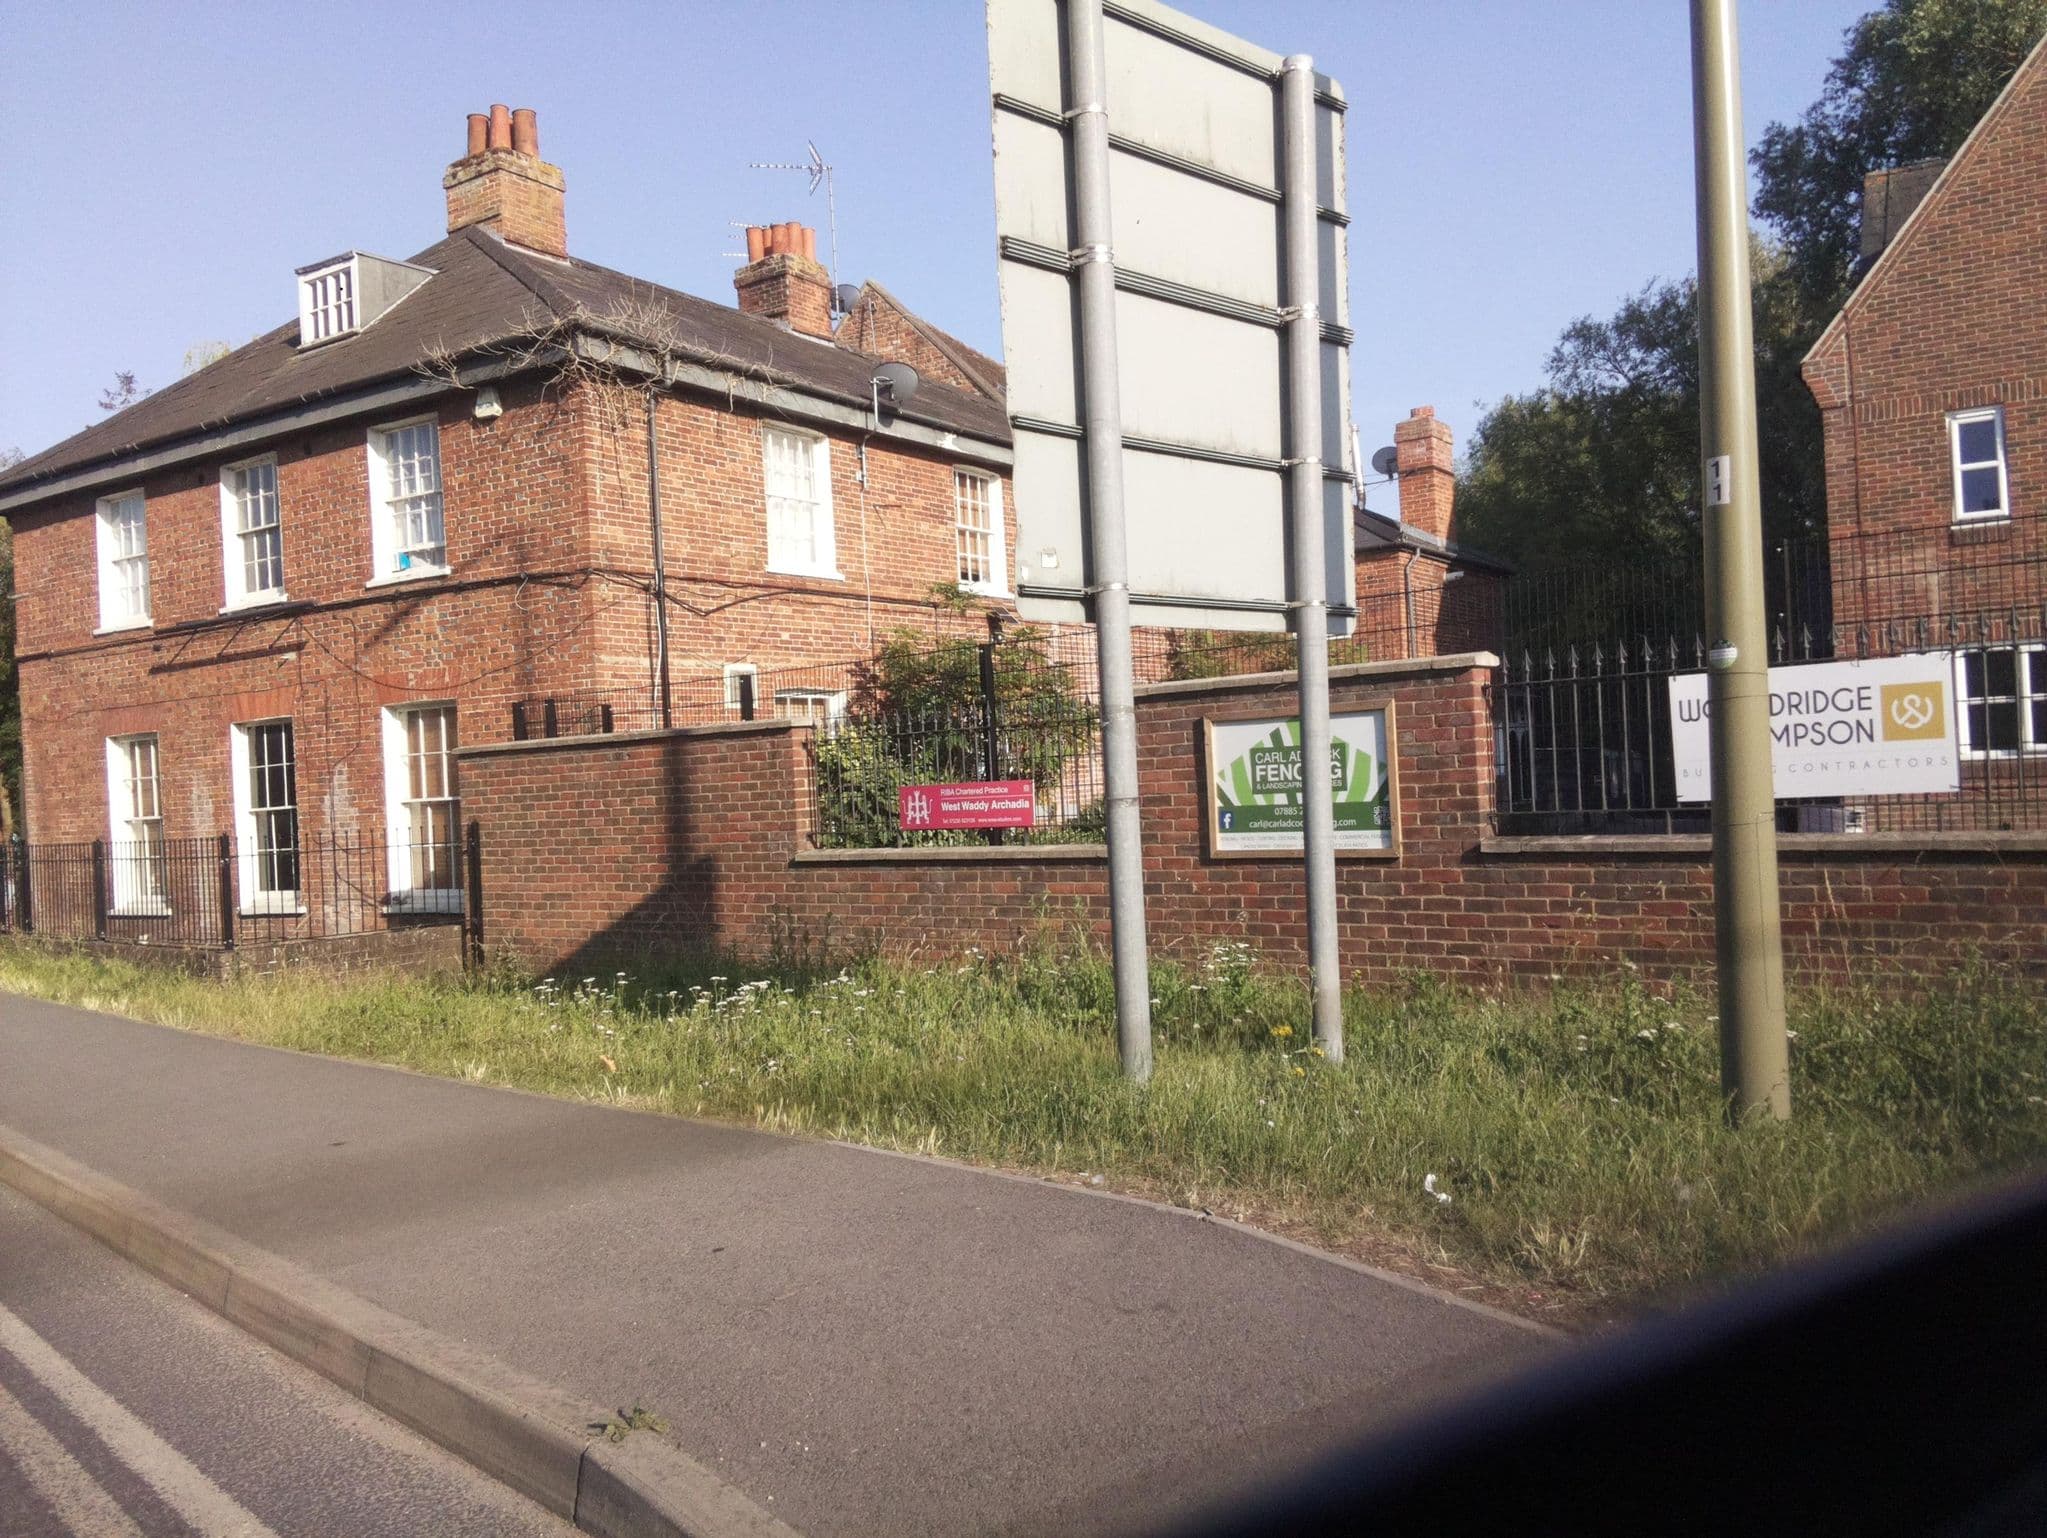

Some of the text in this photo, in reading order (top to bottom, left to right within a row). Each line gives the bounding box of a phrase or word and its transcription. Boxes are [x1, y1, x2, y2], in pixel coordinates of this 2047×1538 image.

[1679, 686, 1872, 723] WDRIDGE
[1769, 718, 1874, 747] MPSON
[1255, 752, 1286, 764] CARL
[1788, 756, 1949, 773] CONTRACTORS
[1256, 761, 1342, 782] FENCG
[955, 787, 984, 795] Chartered
[984, 786, 1008, 794] Practice
[1262, 781, 1302, 790] LANDSCAPIN
[941, 799, 1029, 812] West Waddy Archadia
[1274, 807, 1297, 816] 07885
